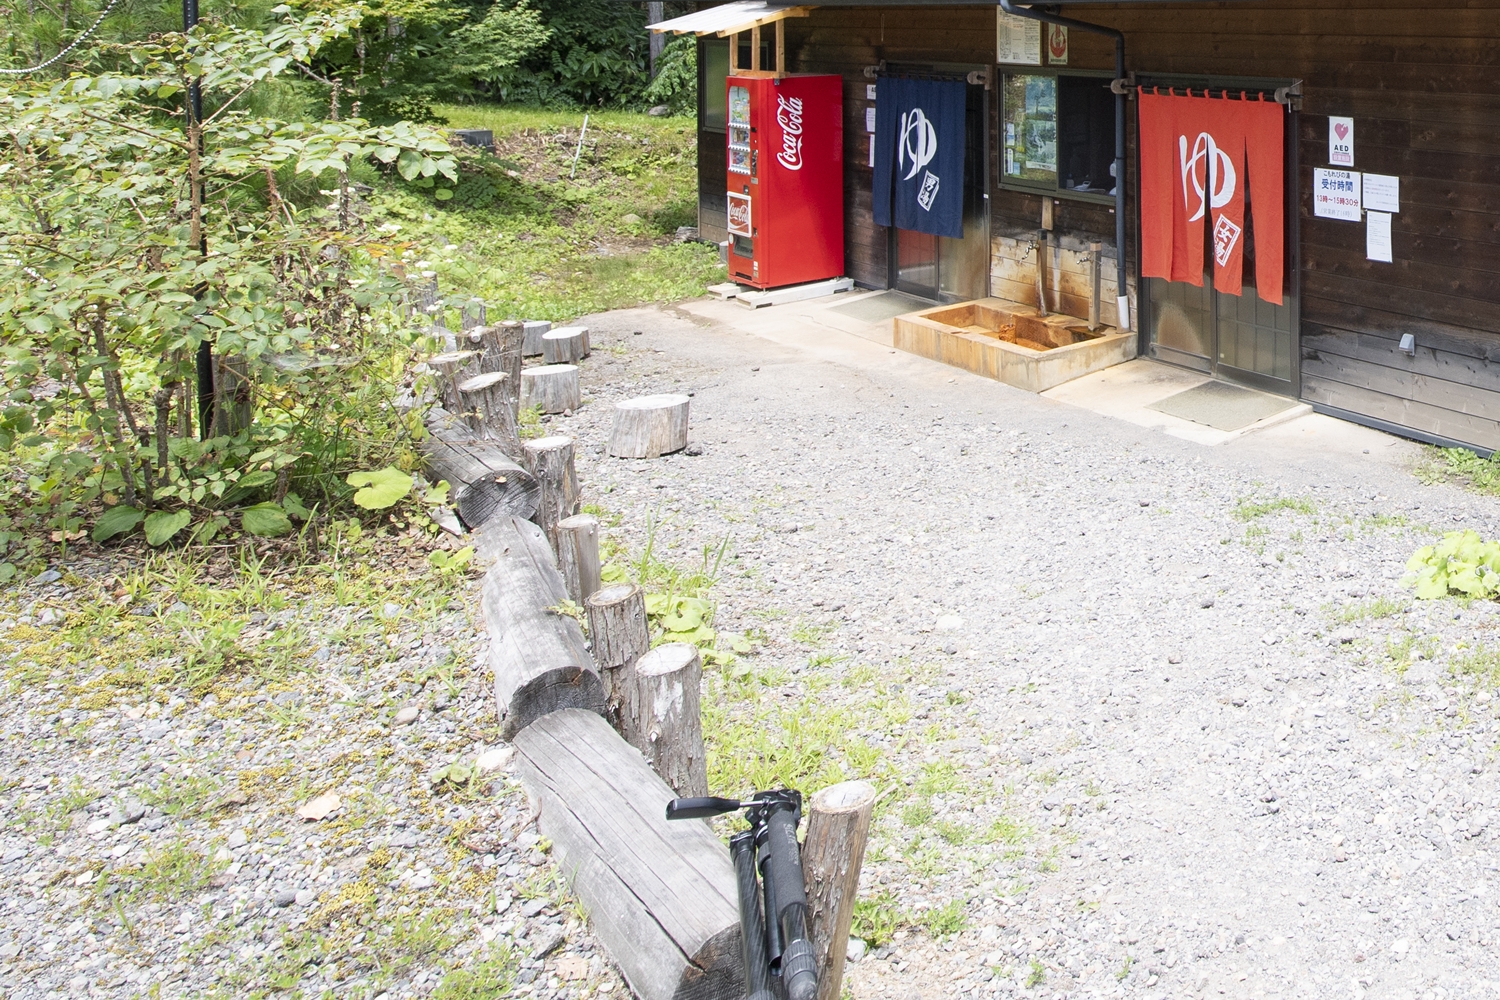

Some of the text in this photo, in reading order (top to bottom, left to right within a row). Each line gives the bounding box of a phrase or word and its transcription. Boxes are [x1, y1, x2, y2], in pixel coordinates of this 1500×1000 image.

[776, 93, 803, 171] Coca-Cola
[898, 108, 938, 181] ゆ
[1334, 144, 1349, 152] AED
[1178, 132, 1237, 222] ゆ
[1321, 178, 1354, 193] 受付時間
[1323, 170, 1351, 179] こもれびの湯
